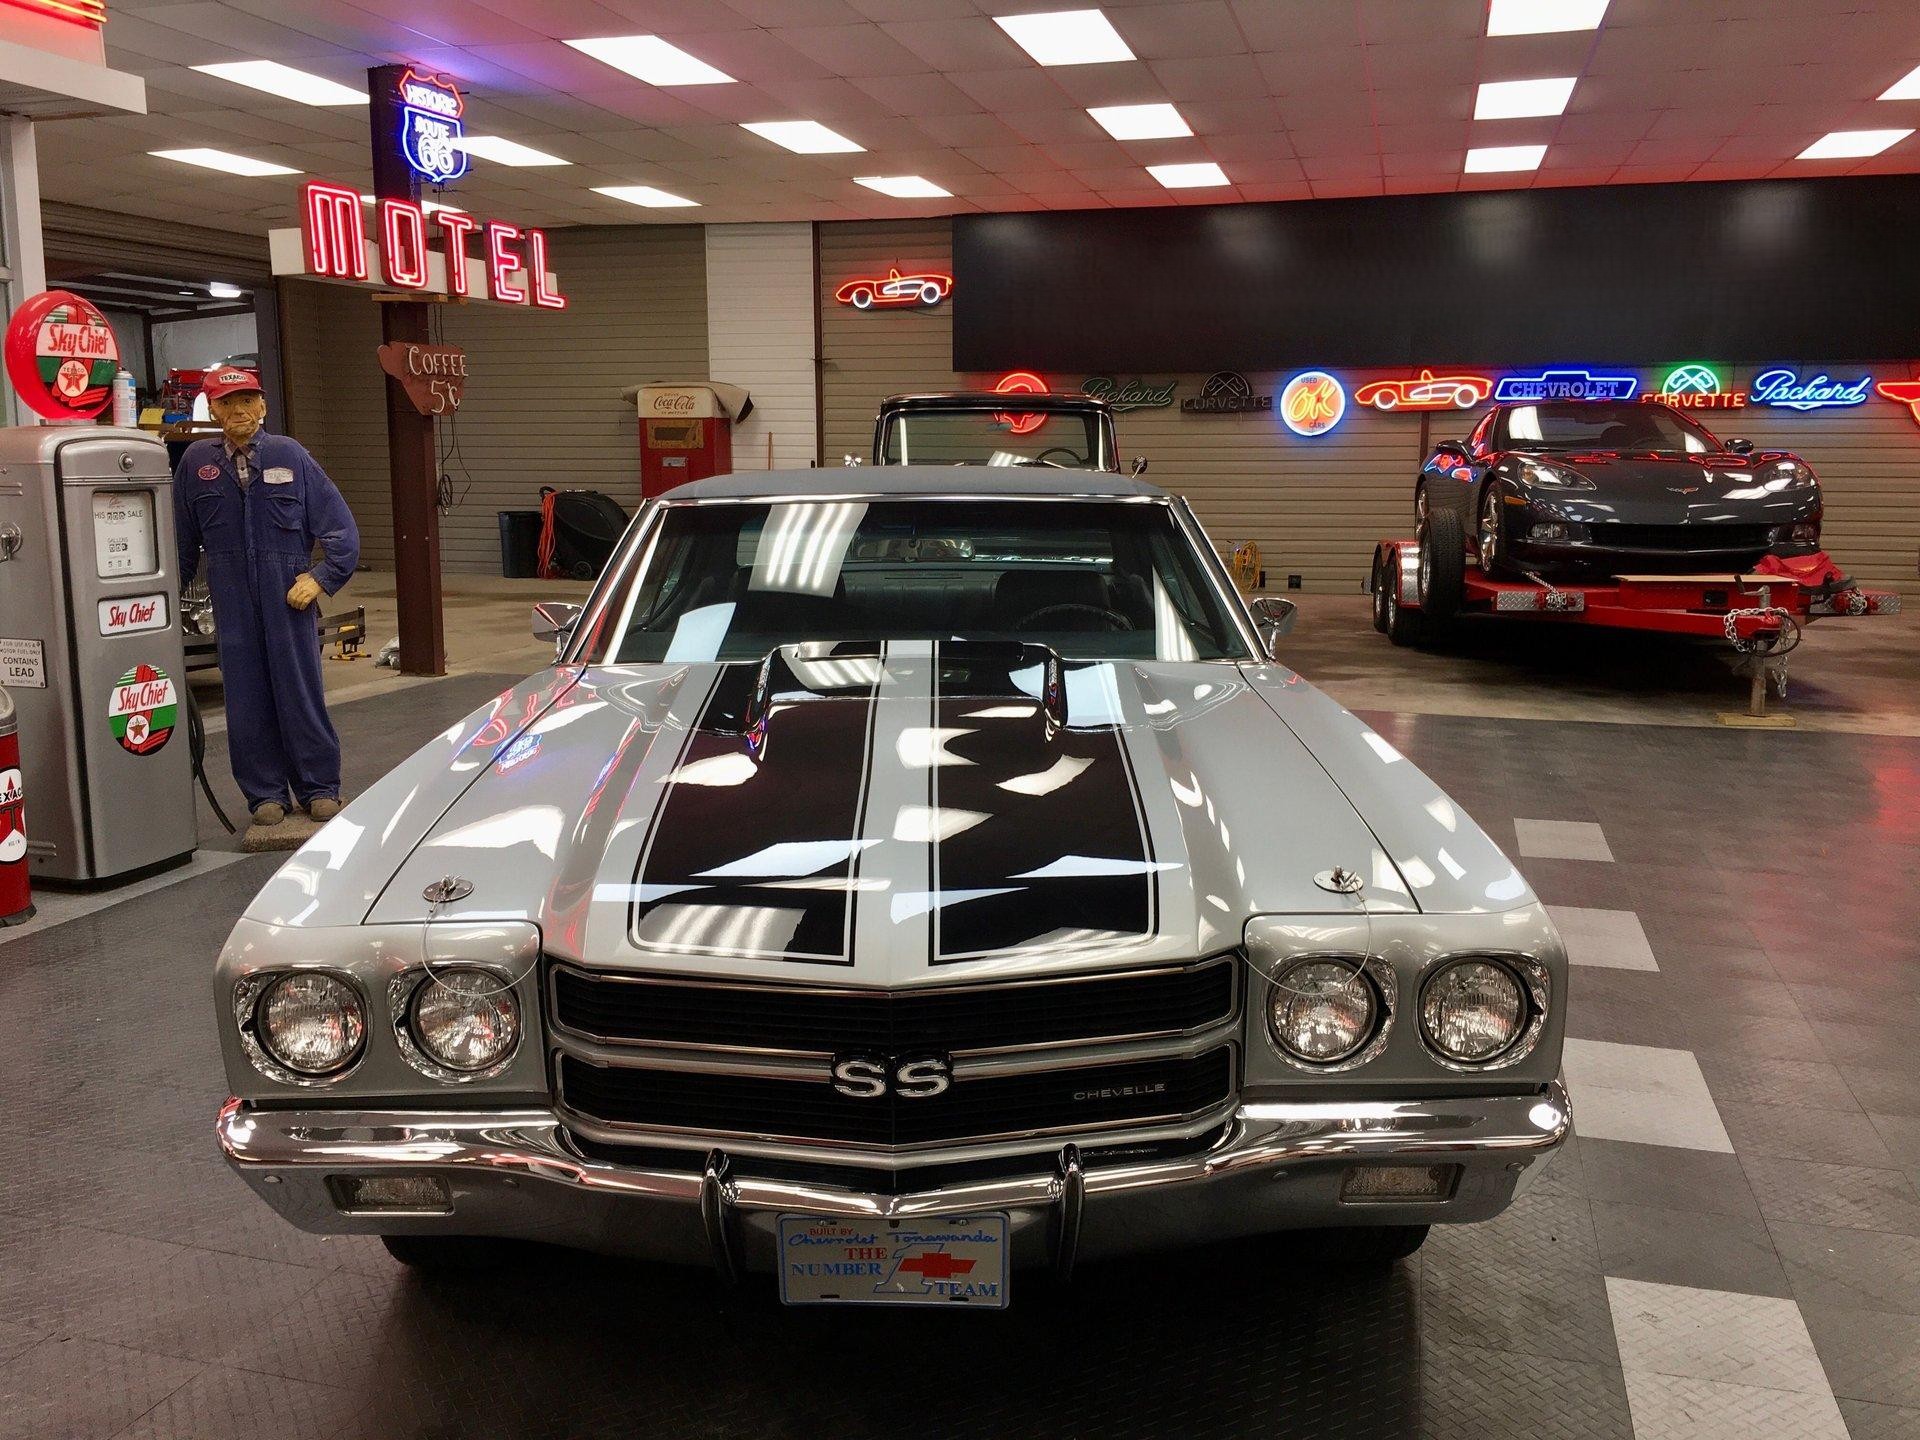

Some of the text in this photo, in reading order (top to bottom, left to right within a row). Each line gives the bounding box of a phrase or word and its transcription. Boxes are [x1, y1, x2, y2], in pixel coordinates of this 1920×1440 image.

[415, 116, 450, 139] ROUTE
[418, 134, 454, 174] 66
[301, 180, 567, 311] MOTEL
[48, 324, 109, 355] Sky Chief
[409, 346, 469, 377] COFFEE
[1081, 377, 1176, 406] Packard
[1509, 381, 1619, 397] CHEVROLET
[1751, 370, 1871, 406] Packard
[1183, 396, 1271, 411] CORVETTE
[1288, 380, 1337, 422] OK
[128, 510, 144, 518] SALE
[109, 601, 156, 627] Sky Chief
[3, 656, 39, 666] CONTAINS
[9, 667, 35, 677] LEAD
[118, 681, 168, 711] Sky Chief
[834, 1060, 949, 1097] SS
[1073, 1083, 1166, 1100] CHEVELLE
[788, 1230, 998, 1246] Chevrolet Tonawanda
[809, 1228, 854, 1236] BUILT BY
[844, 1248, 888, 1260] THE
[791, 1262, 882, 1277] NUMBER
[935, 1280, 999, 1297] TEAM
